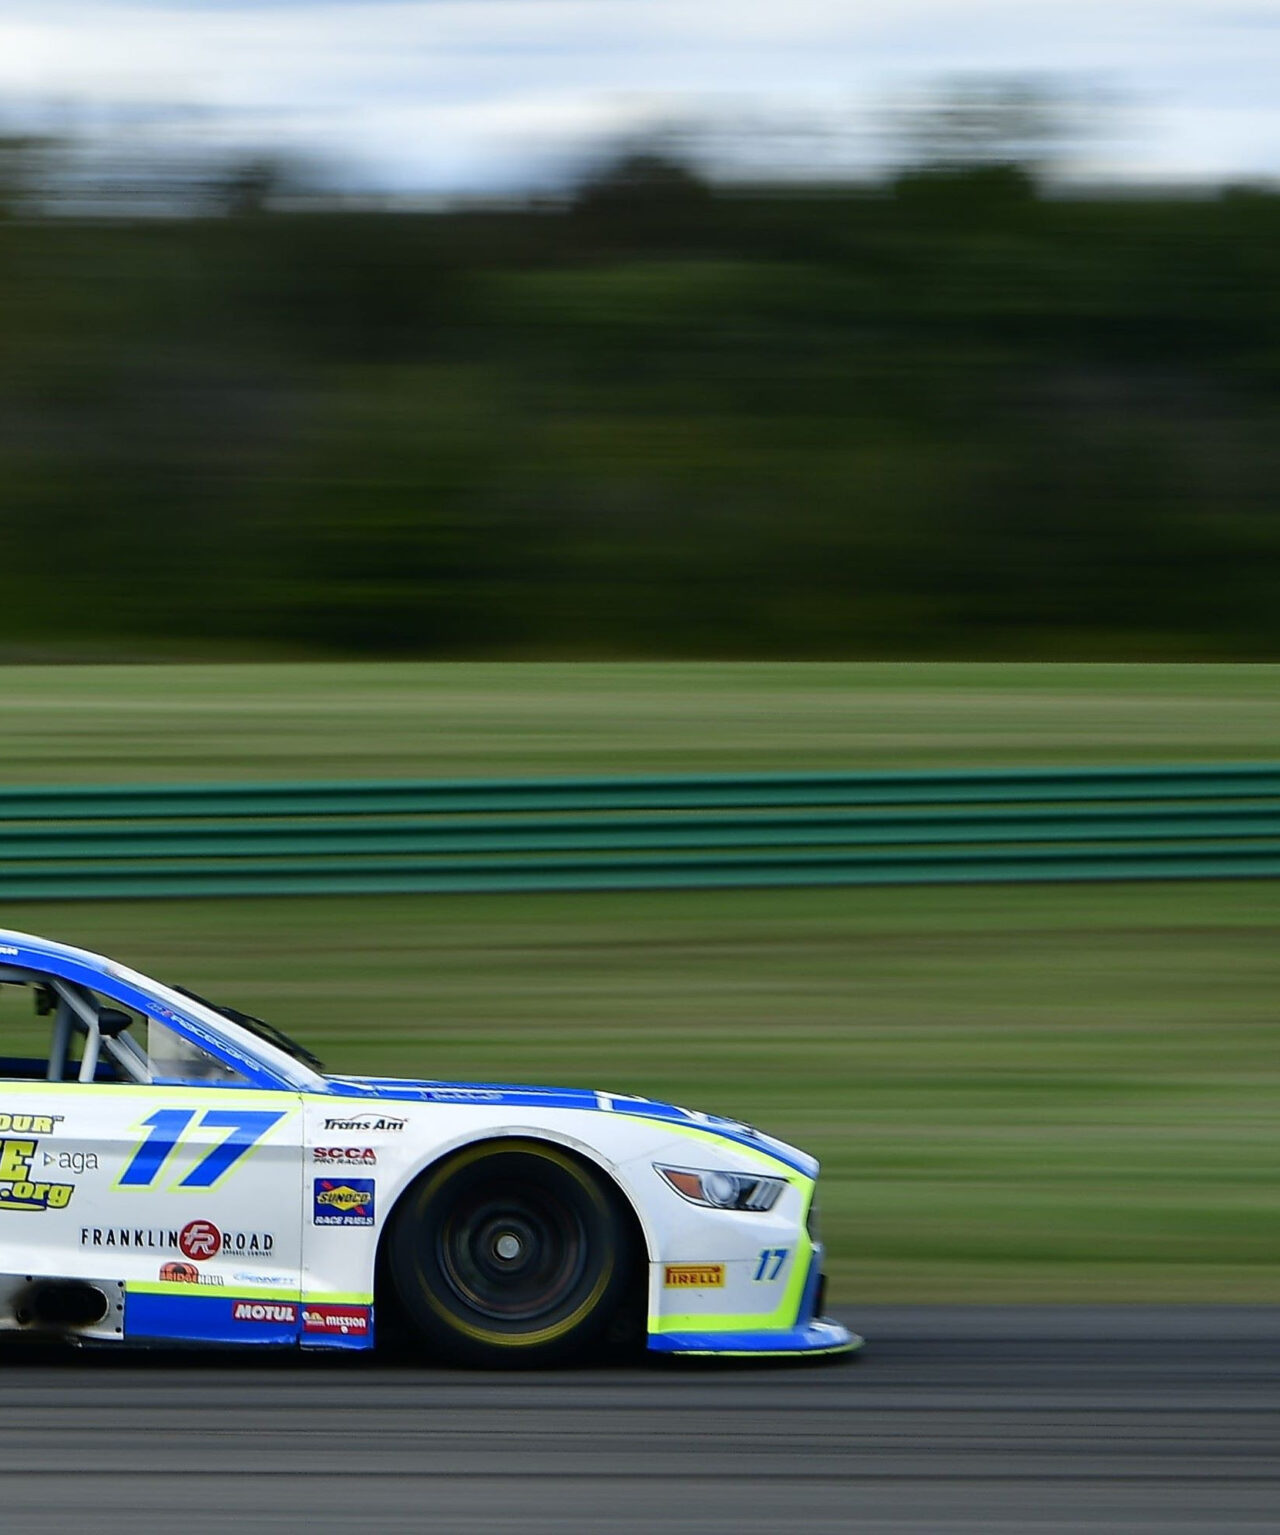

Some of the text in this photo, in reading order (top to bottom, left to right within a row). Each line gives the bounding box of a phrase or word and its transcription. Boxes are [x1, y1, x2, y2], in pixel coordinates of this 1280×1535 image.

[324, 1118, 405, 1130] Trans Am
[113, 1106, 294, 1190] 17
[312, 1147, 376, 1159] SCCA
[59, 1152, 98, 1174] aga
[0, 1180, 75, 1209] .org
[319, 1193, 369, 1203] SUNOCO
[315, 1216, 373, 1226] RACE FUELS
[81, 1228, 178, 1248] FRANKLIN
[223, 1233, 274, 1250] ROAD
[753, 1248, 789, 1281] 17
[665, 1266, 721, 1284] PIRELLI
[235, 1304, 295, 1321] MOTUL
